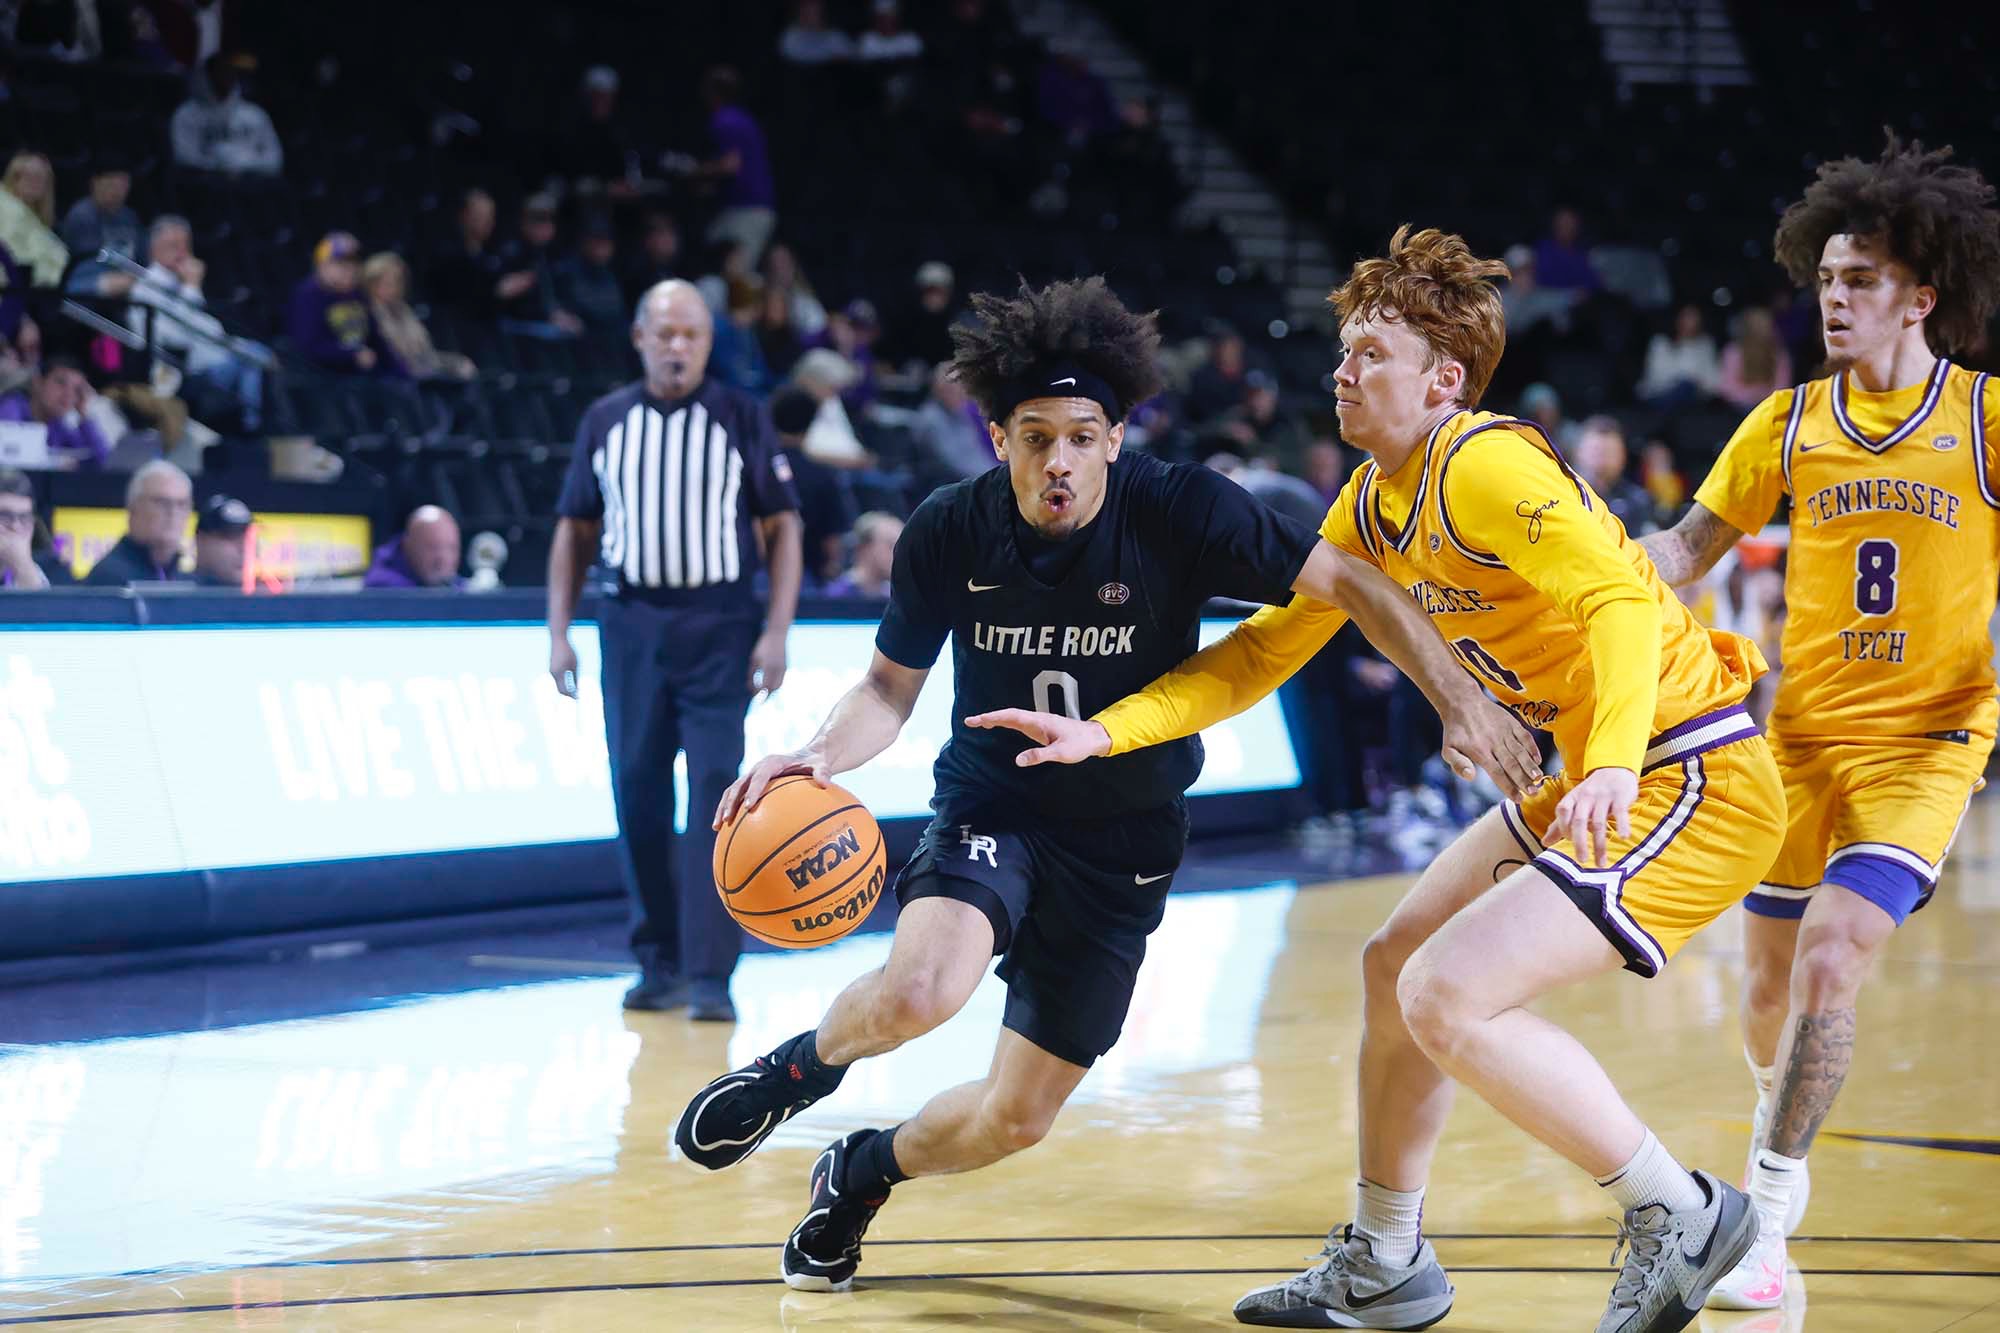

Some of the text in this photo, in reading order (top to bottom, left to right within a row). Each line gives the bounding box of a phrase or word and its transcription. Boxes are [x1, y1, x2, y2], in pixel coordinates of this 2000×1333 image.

[1807, 479, 1960, 528] TENNESSEE
[1856, 539, 1898, 617] 8
[974, 622, 1136, 656] LITTLE ROCK
[1838, 631, 1907, 663] TECH
[257, 674, 416, 801] LIVE
[402, 672, 538, 794] THE
[785, 827, 861, 890] NCAA
[792, 865, 885, 932] Wilson
